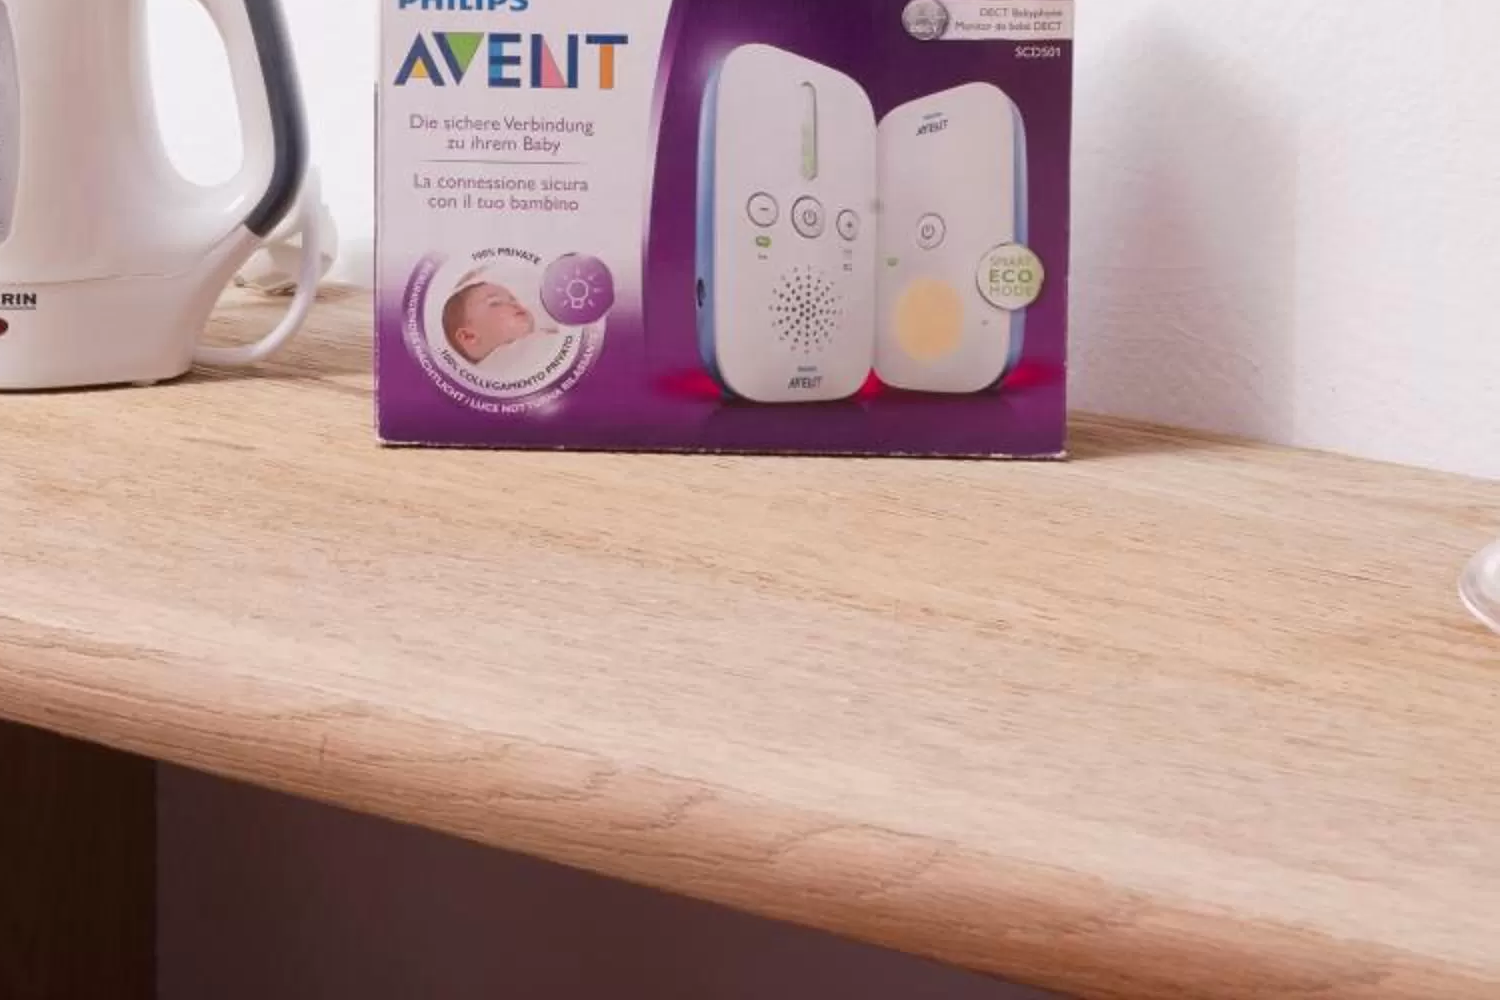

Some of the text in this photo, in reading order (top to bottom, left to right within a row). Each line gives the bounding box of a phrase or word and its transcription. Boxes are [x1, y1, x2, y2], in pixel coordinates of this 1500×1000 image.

[393, 31, 629, 90] AVENT
[409, 113, 596, 137] Die sichere Verbindung
[447, 135, 562, 156] zu ihrem Baby
[413, 173, 589, 192] La connessione sicura
[427, 194, 580, 212] con il tuo bambino
[989, 268, 1034, 283] ECO
[989, 284, 1035, 297] MODE
[545, 335, 574, 375] PRIVATO
